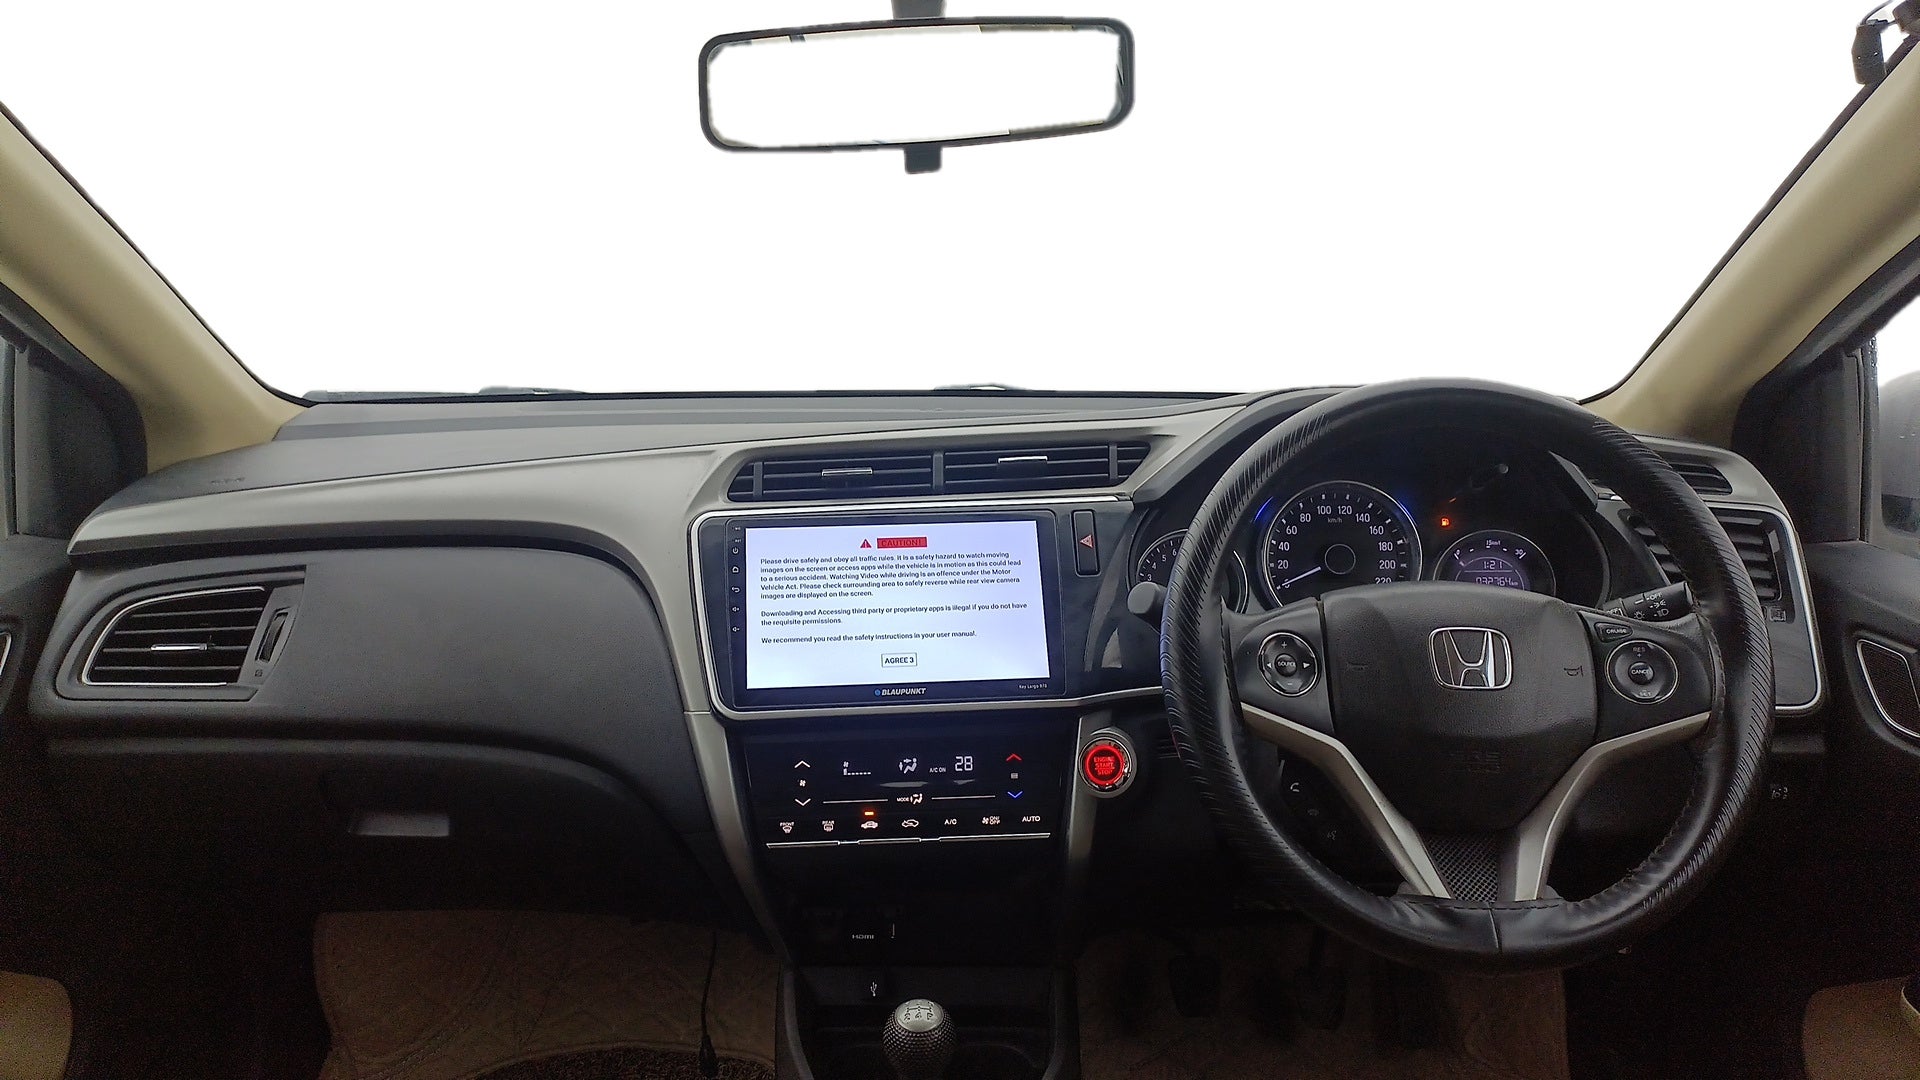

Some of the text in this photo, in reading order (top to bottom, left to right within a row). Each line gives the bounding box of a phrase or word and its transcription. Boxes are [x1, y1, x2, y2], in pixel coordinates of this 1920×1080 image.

[1316, 505, 1332, 515] 100
[1337, 505, 1353, 515] 120
[1299, 513, 1312, 523] 80
[1355, 513, 1371, 523] 140
[1285, 526, 1298, 535] 60
[1369, 526, 1384, 535] 160
[1278, 541, 1290, 551] 40
[1378, 541, 1393, 552] 180
[800, 557, 819, 565] safely
[834, 556, 849, 564] obey
[915, 553, 934, 561] safety
[986, 551, 1009, 559] moving
[1162, 554, 1167, 562] 5
[1277, 560, 1289, 569] 20
[1379, 560, 1396, 569] 200
[830, 572, 859, 581] Watching
[898, 570, 919, 579] driving
[843, 580, 880, 589] surrounding
[905, 579, 923, 587] safely
[797, 591, 827, 599] displayed
[1649, 592, 1663, 600] OFF
[760, 609, 803, 618] Downloading
[818, 607, 851, 616] Accessing
[868, 606, 884, 615] party
[894, 605, 927, 614] proprietary
[773, 618, 801, 626] requisite
[773, 635, 812, 643] recommend
[855, 633, 874, 642] safety
[875, 632, 912, 640] instructions
[881, 688, 926, 696] BLAUPUNKT
[955, 756, 973, 771] 28
